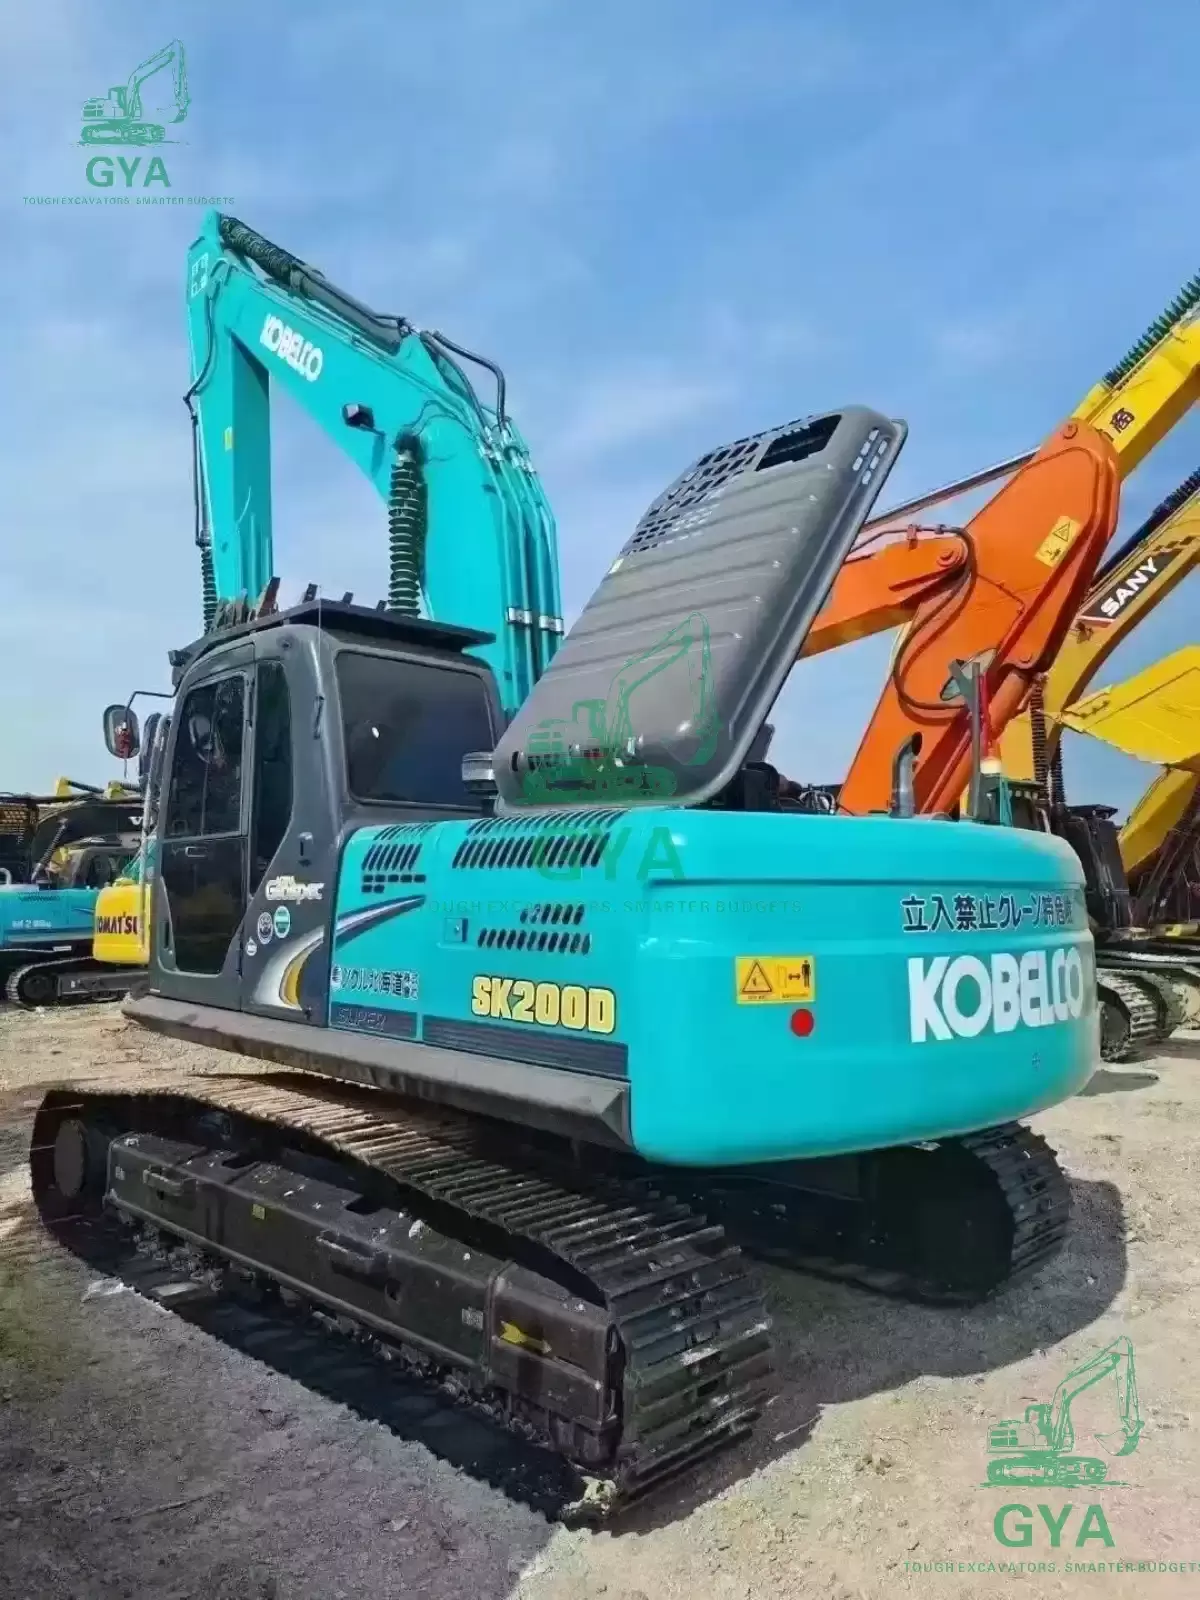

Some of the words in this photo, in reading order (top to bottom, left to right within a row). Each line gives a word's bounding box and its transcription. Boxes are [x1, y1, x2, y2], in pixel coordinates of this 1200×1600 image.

[260, 313, 323, 382] KOBELCO
[1101, 557, 1158, 617] SANY
[471, 974, 616, 1036] SK200D
[908, 946, 1083, 1043] KOBELCO
